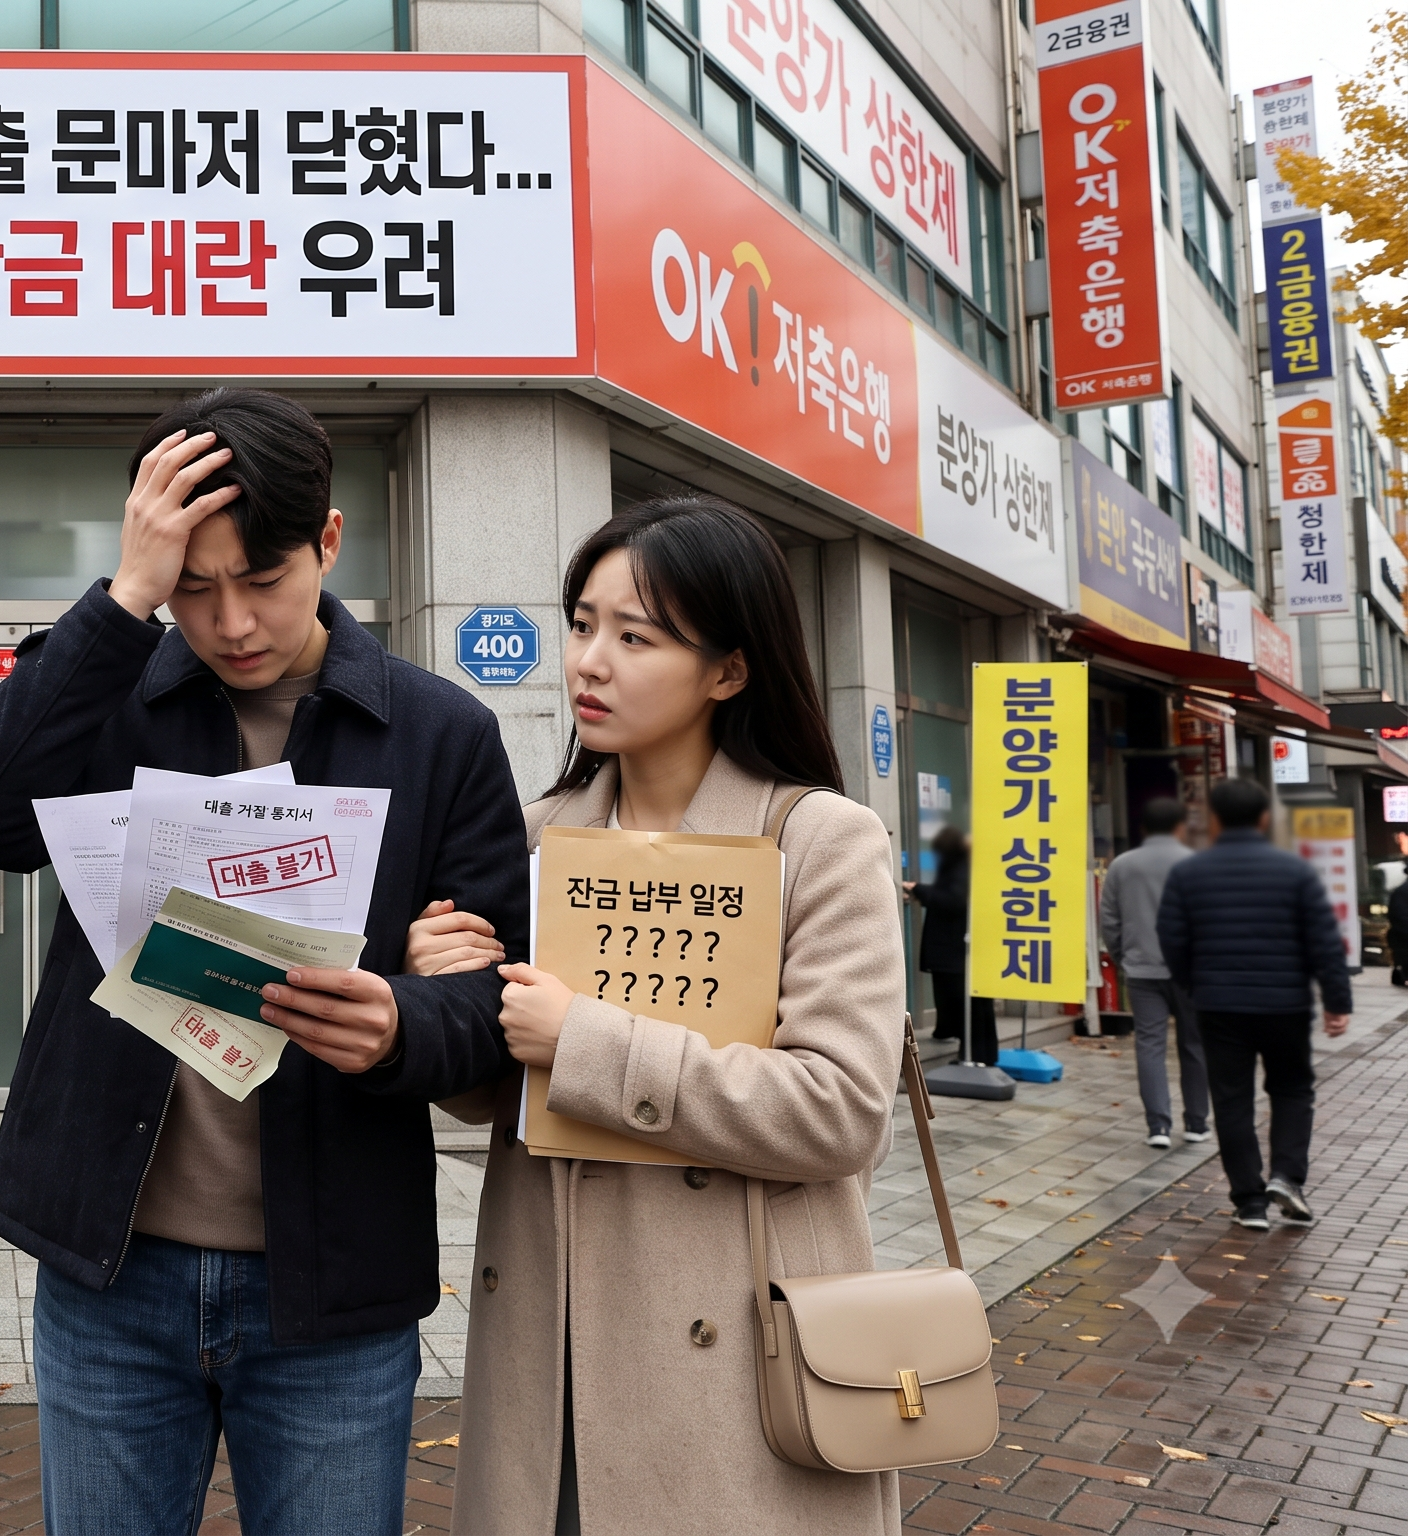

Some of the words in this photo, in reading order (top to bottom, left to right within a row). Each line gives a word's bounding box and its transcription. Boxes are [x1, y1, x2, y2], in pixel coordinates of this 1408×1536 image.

[1047, 12, 1131, 53] 2금융권
[54, 106, 260, 195] 문마저
[286, 106, 553, 196] 닫혔다...
[863, 77, 960, 266] 상한제
[110, 219, 276, 317] 대란
[300, 221, 454, 318] 우려
[1276, 229, 1320, 374] 2금융권
[772, 300, 891, 465] 저축은행
[1065, 379, 1096, 396] OK
[936, 404, 997, 518] 분양가
[1003, 452, 1056, 554] 상한제
[473, 634, 524, 658] 400
[1002, 678, 1058, 823] 분양가
[271, 807, 313, 822] 통지서
[220, 860, 270, 887] 대출
[275, 847, 324, 881] 불가
[566, 876, 622, 911] 잔금
[629, 880, 682, 915] 납부
[690, 883, 744, 919] 일정
[1001, 838, 1057, 985] 상한제
